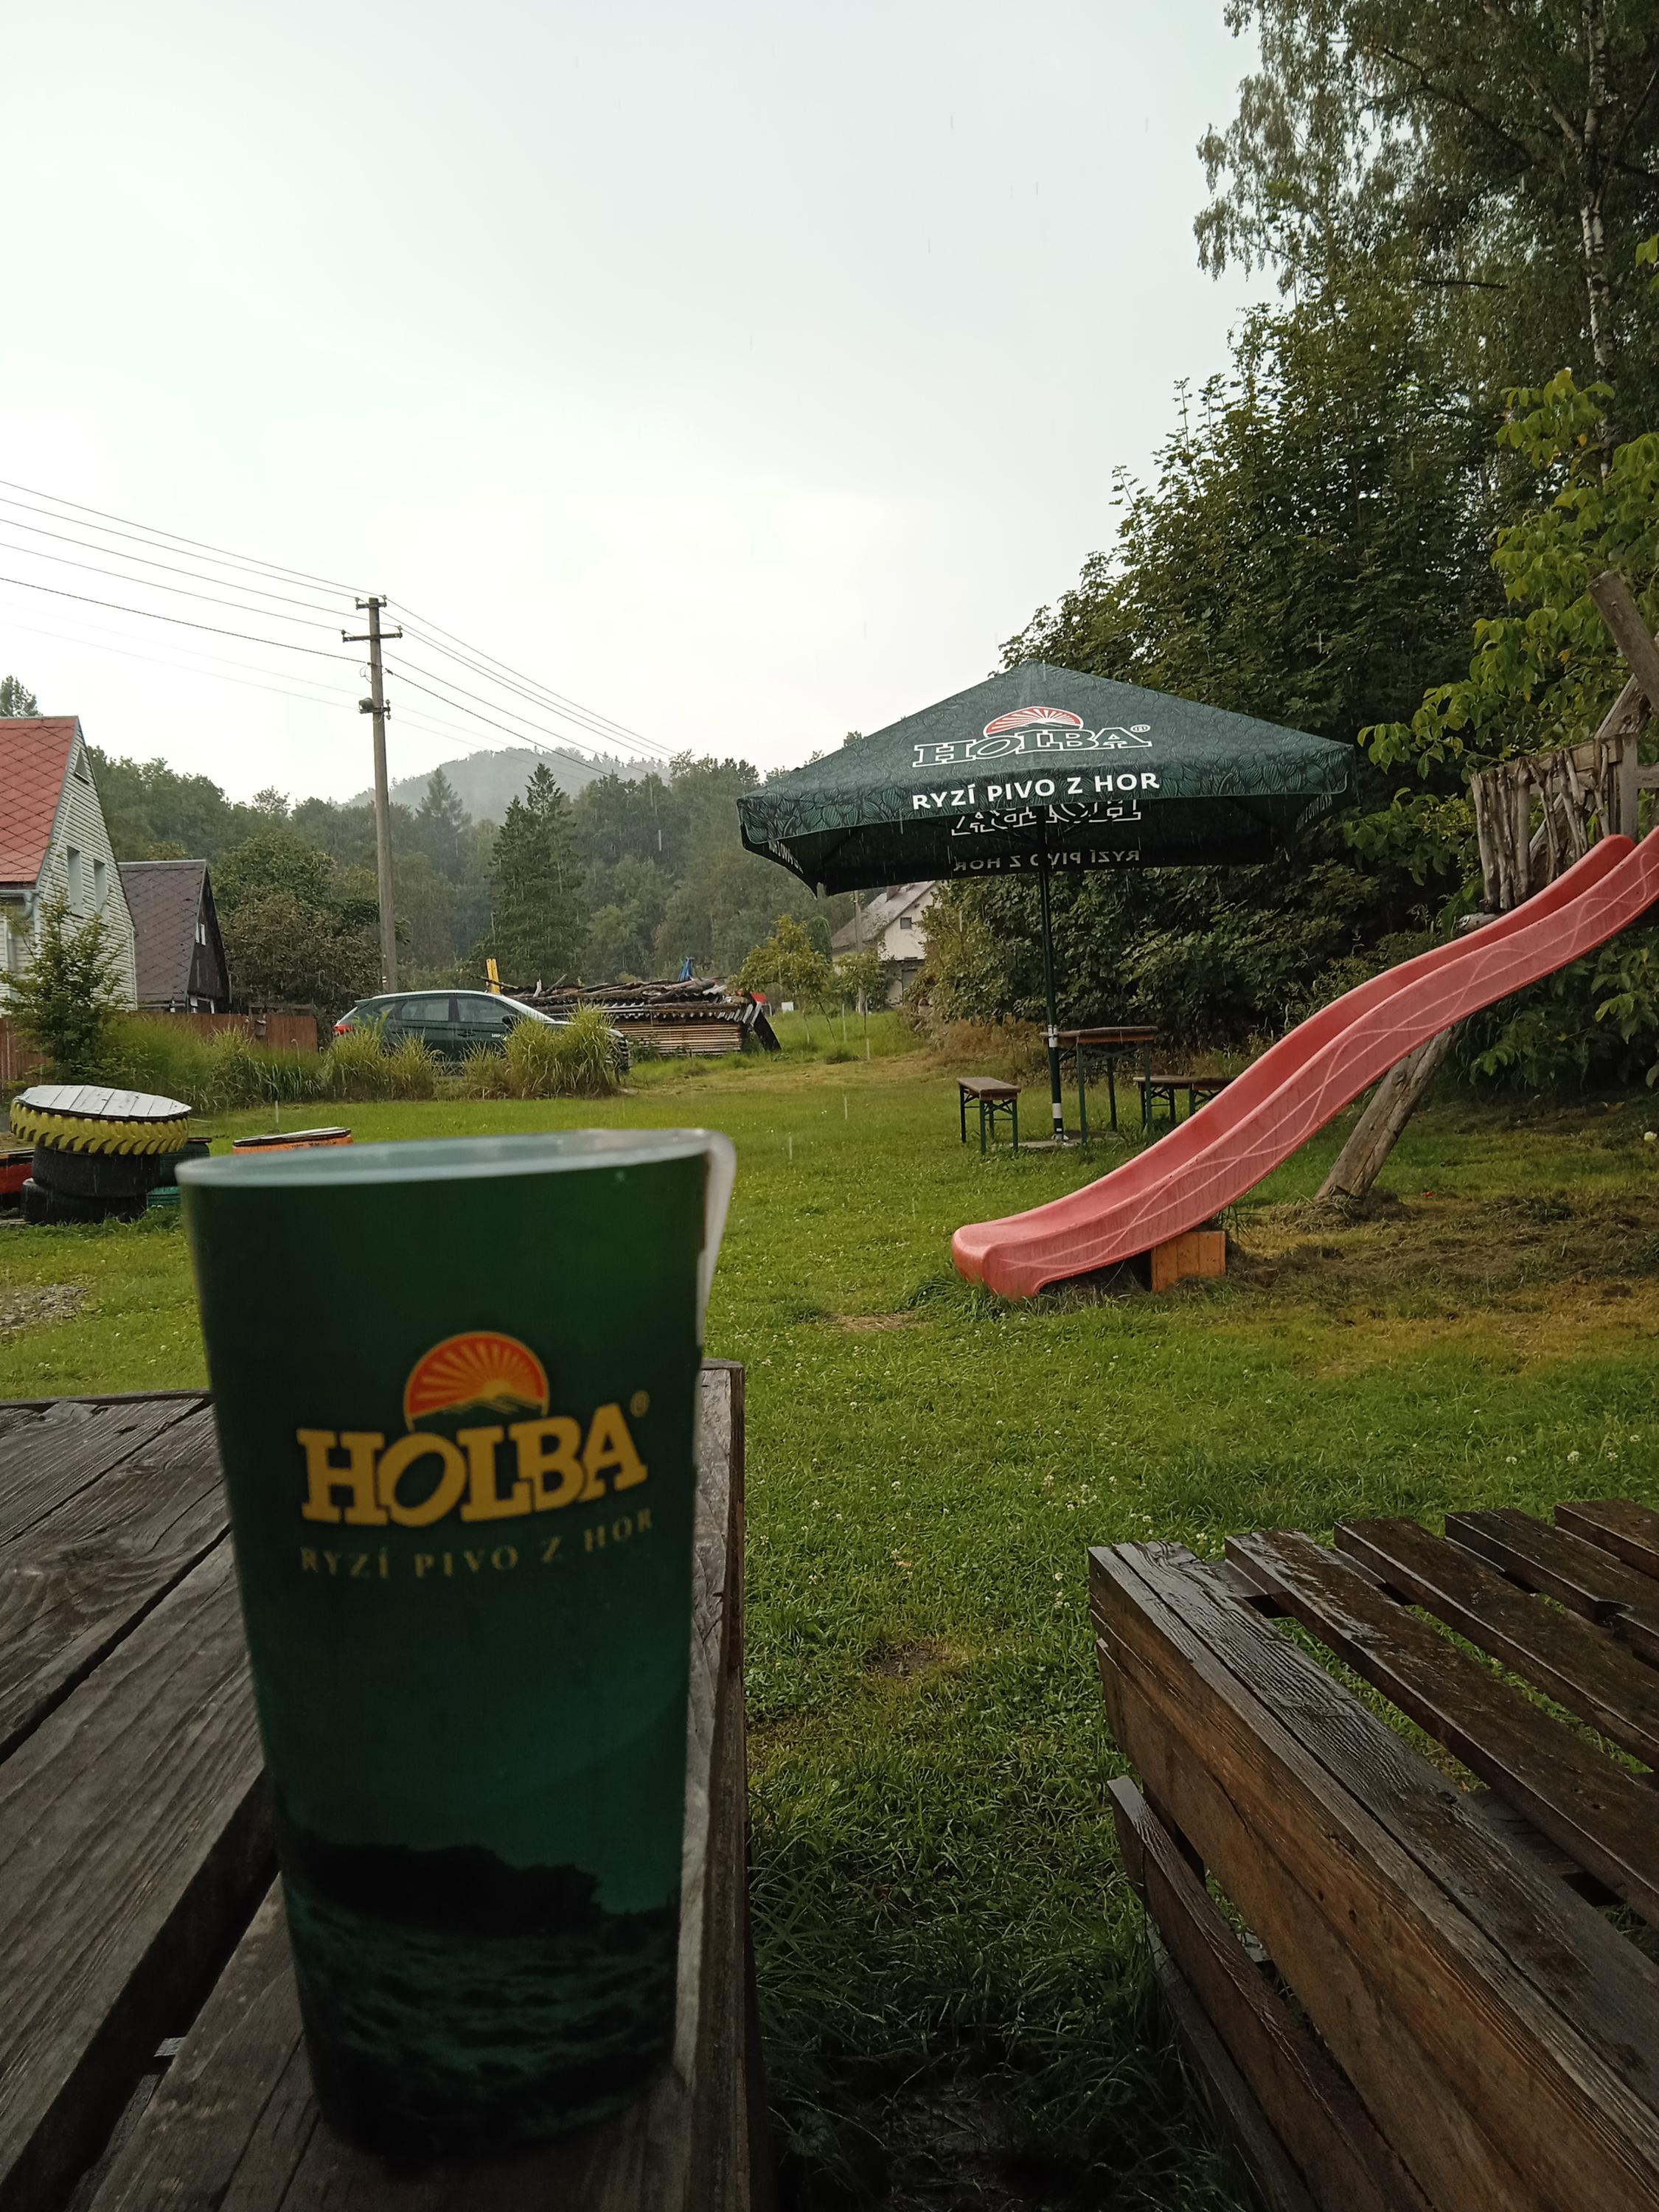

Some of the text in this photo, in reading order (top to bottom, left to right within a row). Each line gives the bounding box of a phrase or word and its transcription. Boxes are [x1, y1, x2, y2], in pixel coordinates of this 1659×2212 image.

[912, 726, 1152, 768] HOLBA
[912, 773, 1160, 810] RYZÍ PIVO Z HOR
[296, 1402, 649, 1528] HOLBA
[299, 1506, 653, 1579] RYZÍ PIVO Z HOR
